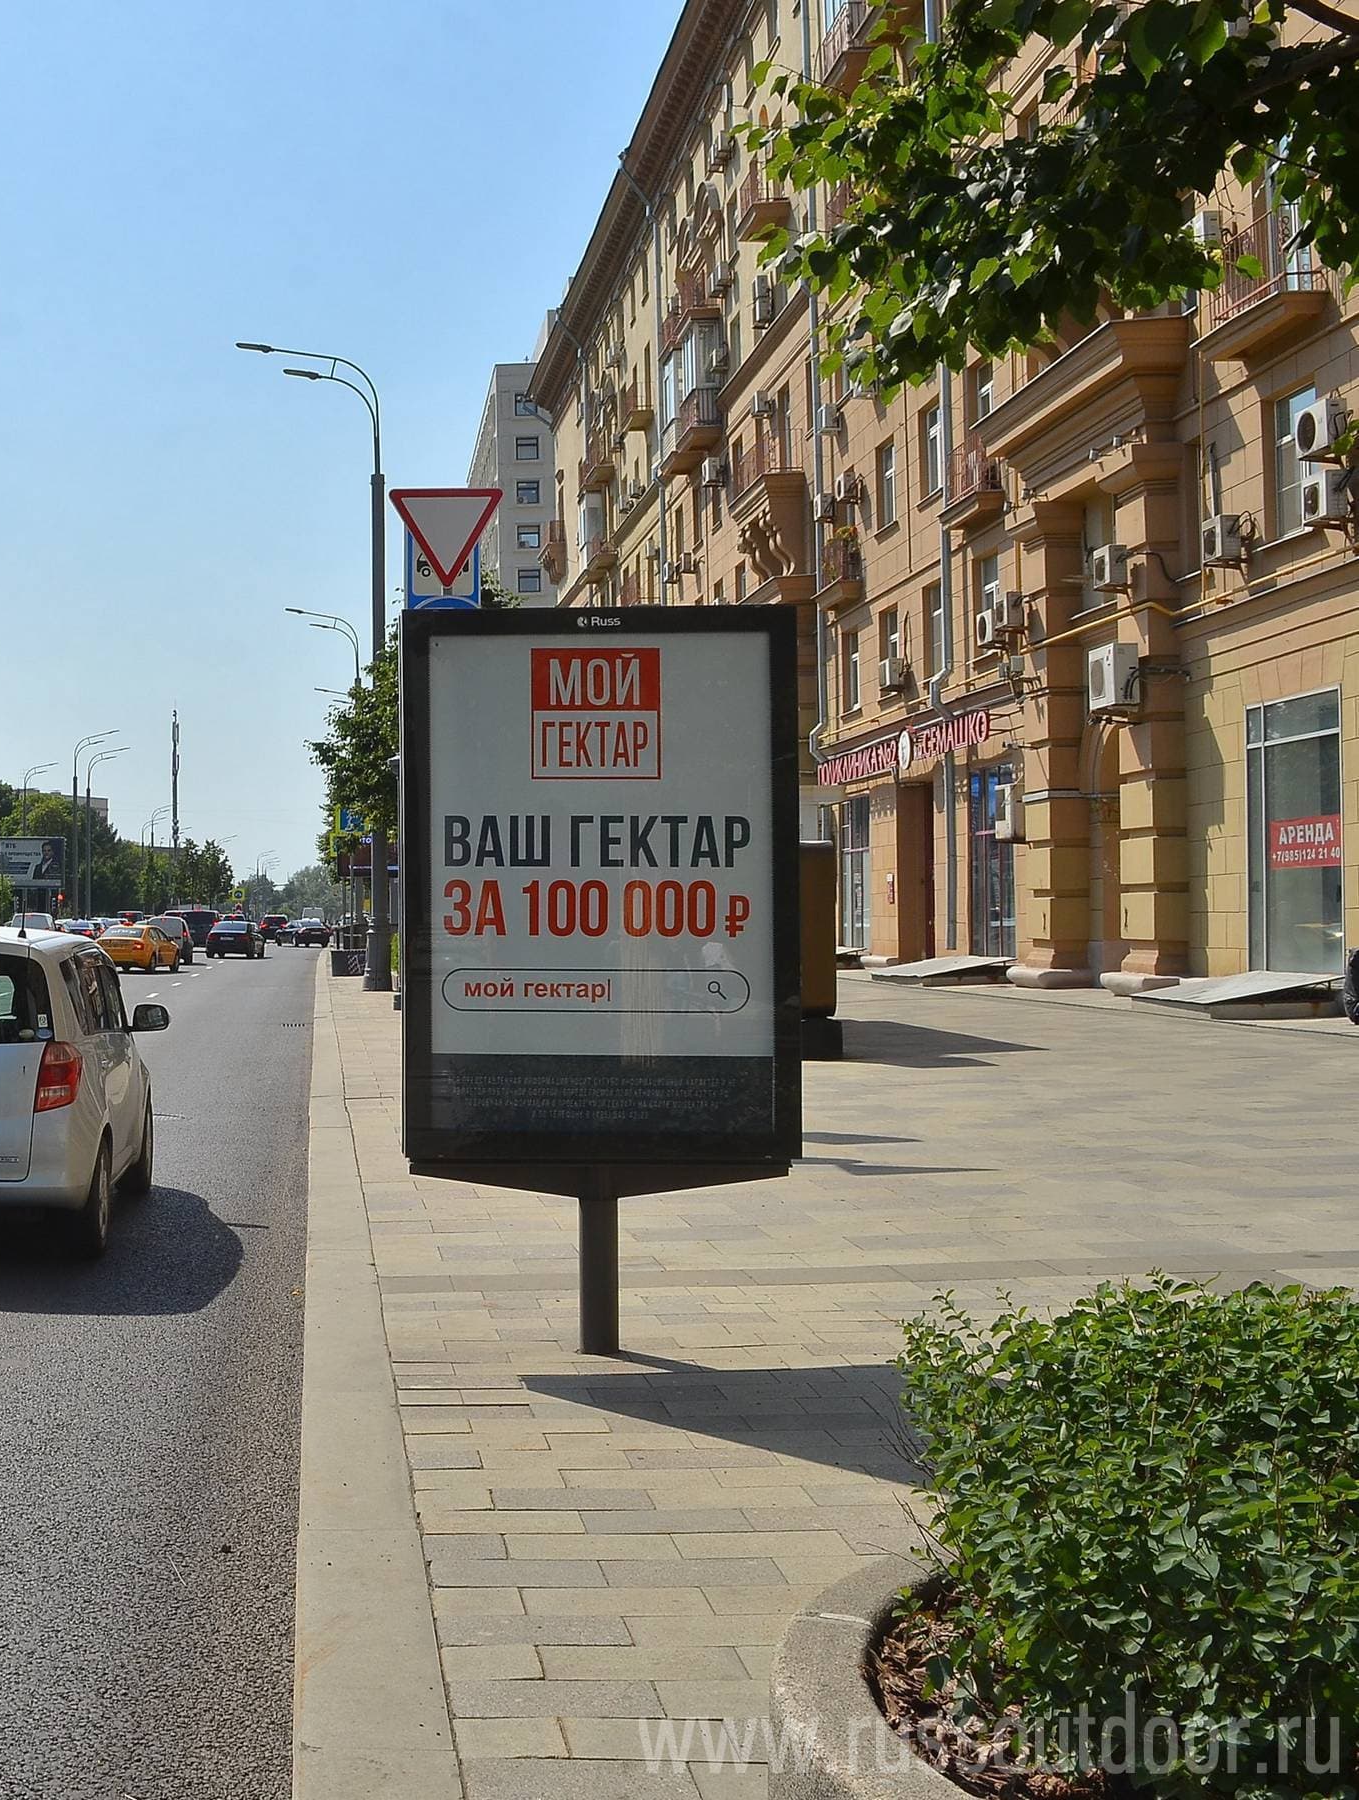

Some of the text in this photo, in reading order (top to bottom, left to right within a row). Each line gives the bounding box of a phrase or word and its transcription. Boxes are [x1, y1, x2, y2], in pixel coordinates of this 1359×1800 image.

[591, 616, 621, 626] Russ
[550, 653, 640, 706] МОЙ
[542, 721, 648, 768] ГЕКТАР
[445, 816, 751, 867] ВАШ ГЕКТАР
[1279, 822, 1334, 845] АРЕНДА
[443, 880, 506, 936] ЗА
[523, 880, 608, 936] 100
[624, 880, 716, 937] 000
[464, 978, 514, 998] мой
